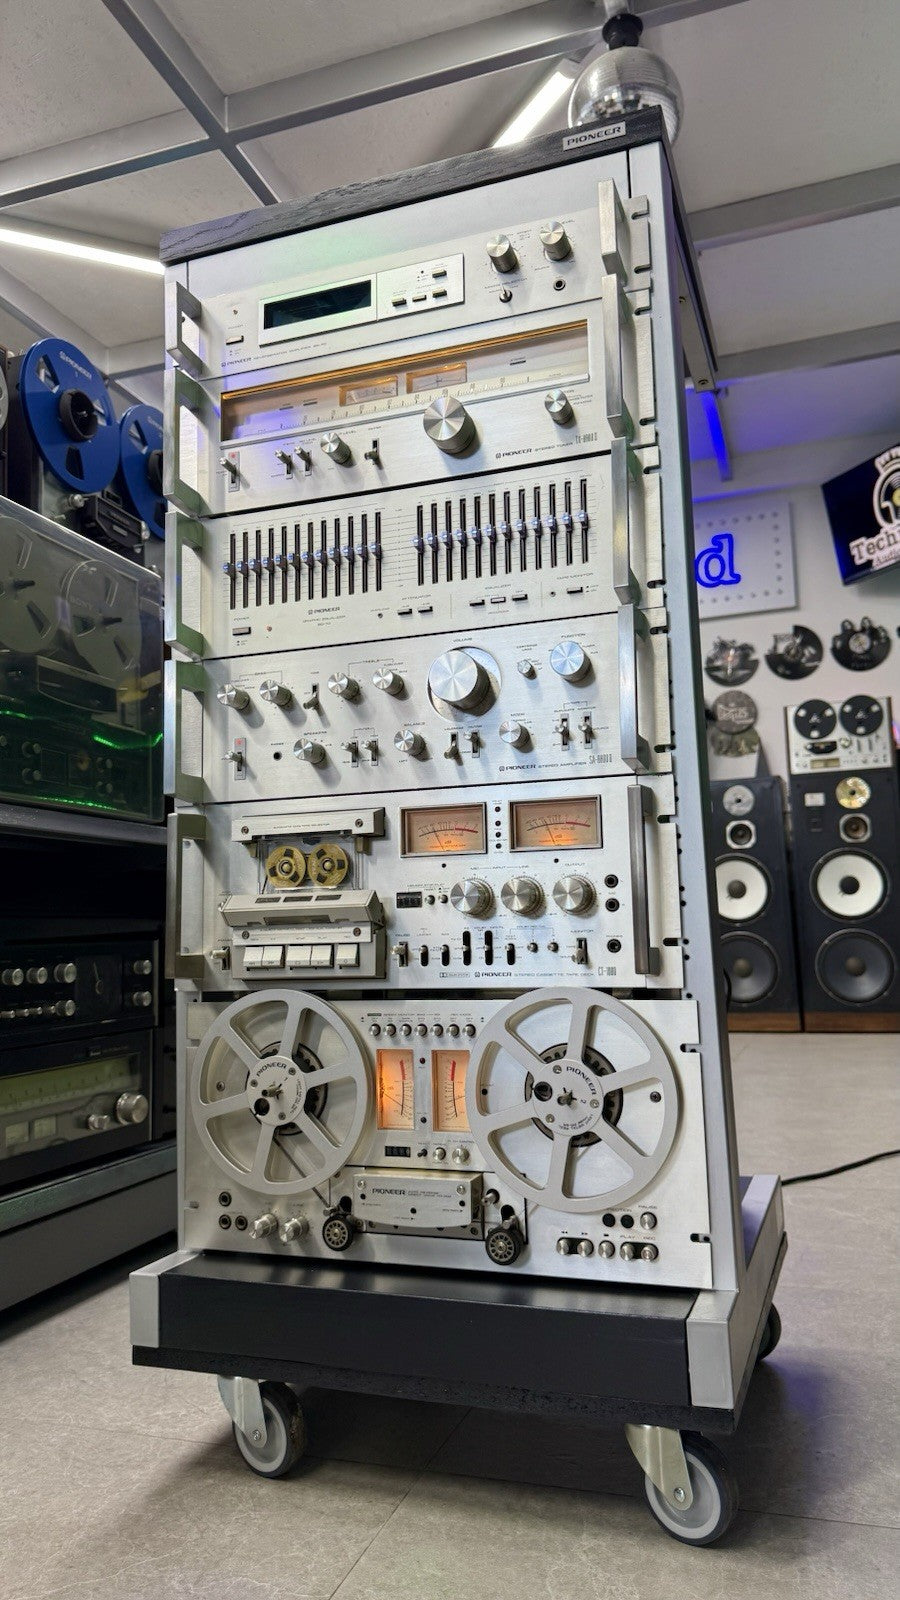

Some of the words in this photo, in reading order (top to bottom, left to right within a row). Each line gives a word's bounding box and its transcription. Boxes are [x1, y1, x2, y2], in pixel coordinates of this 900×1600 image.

[567, 126, 621, 146] PIONEER
[502, 448, 532, 457] PIONEER
[851, 528, 900, 561] Tech
[314, 606, 340, 614] PIONEER
[256, 1062, 287, 1077] PIONEER
[566, 1066, 597, 1095] PIONEER
[372, 1188, 406, 1196] PIONEER
